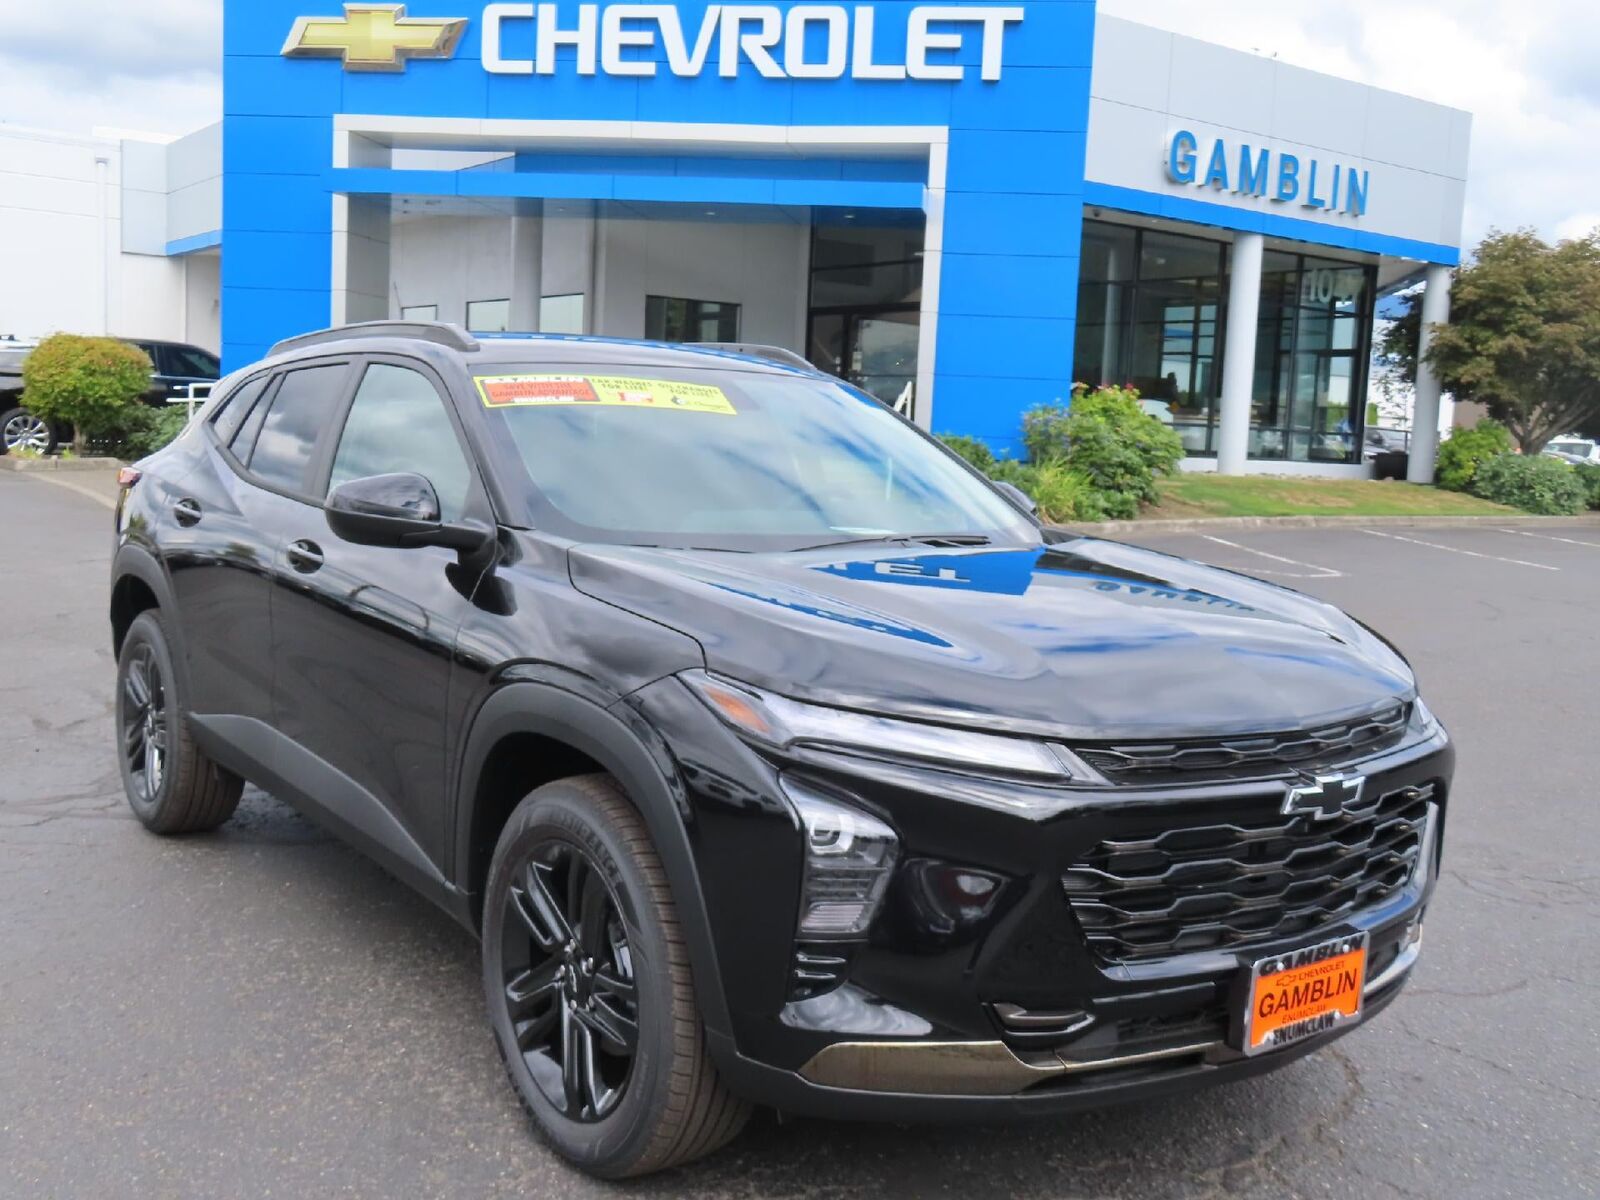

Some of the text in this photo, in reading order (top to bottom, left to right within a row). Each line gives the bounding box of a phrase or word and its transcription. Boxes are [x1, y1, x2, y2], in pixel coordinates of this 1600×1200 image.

[481, 3, 1024, 81] CHEVROLET
[1166, 129, 1369, 216] GAMBLIN
[1259, 935, 1365, 976] GAMBLIN
[1298, 960, 1345, 981] CHEVROLET
[1258, 968, 1358, 1019] GAMBLIN
[1273, 1013, 1336, 1046] ENUMCLAW
